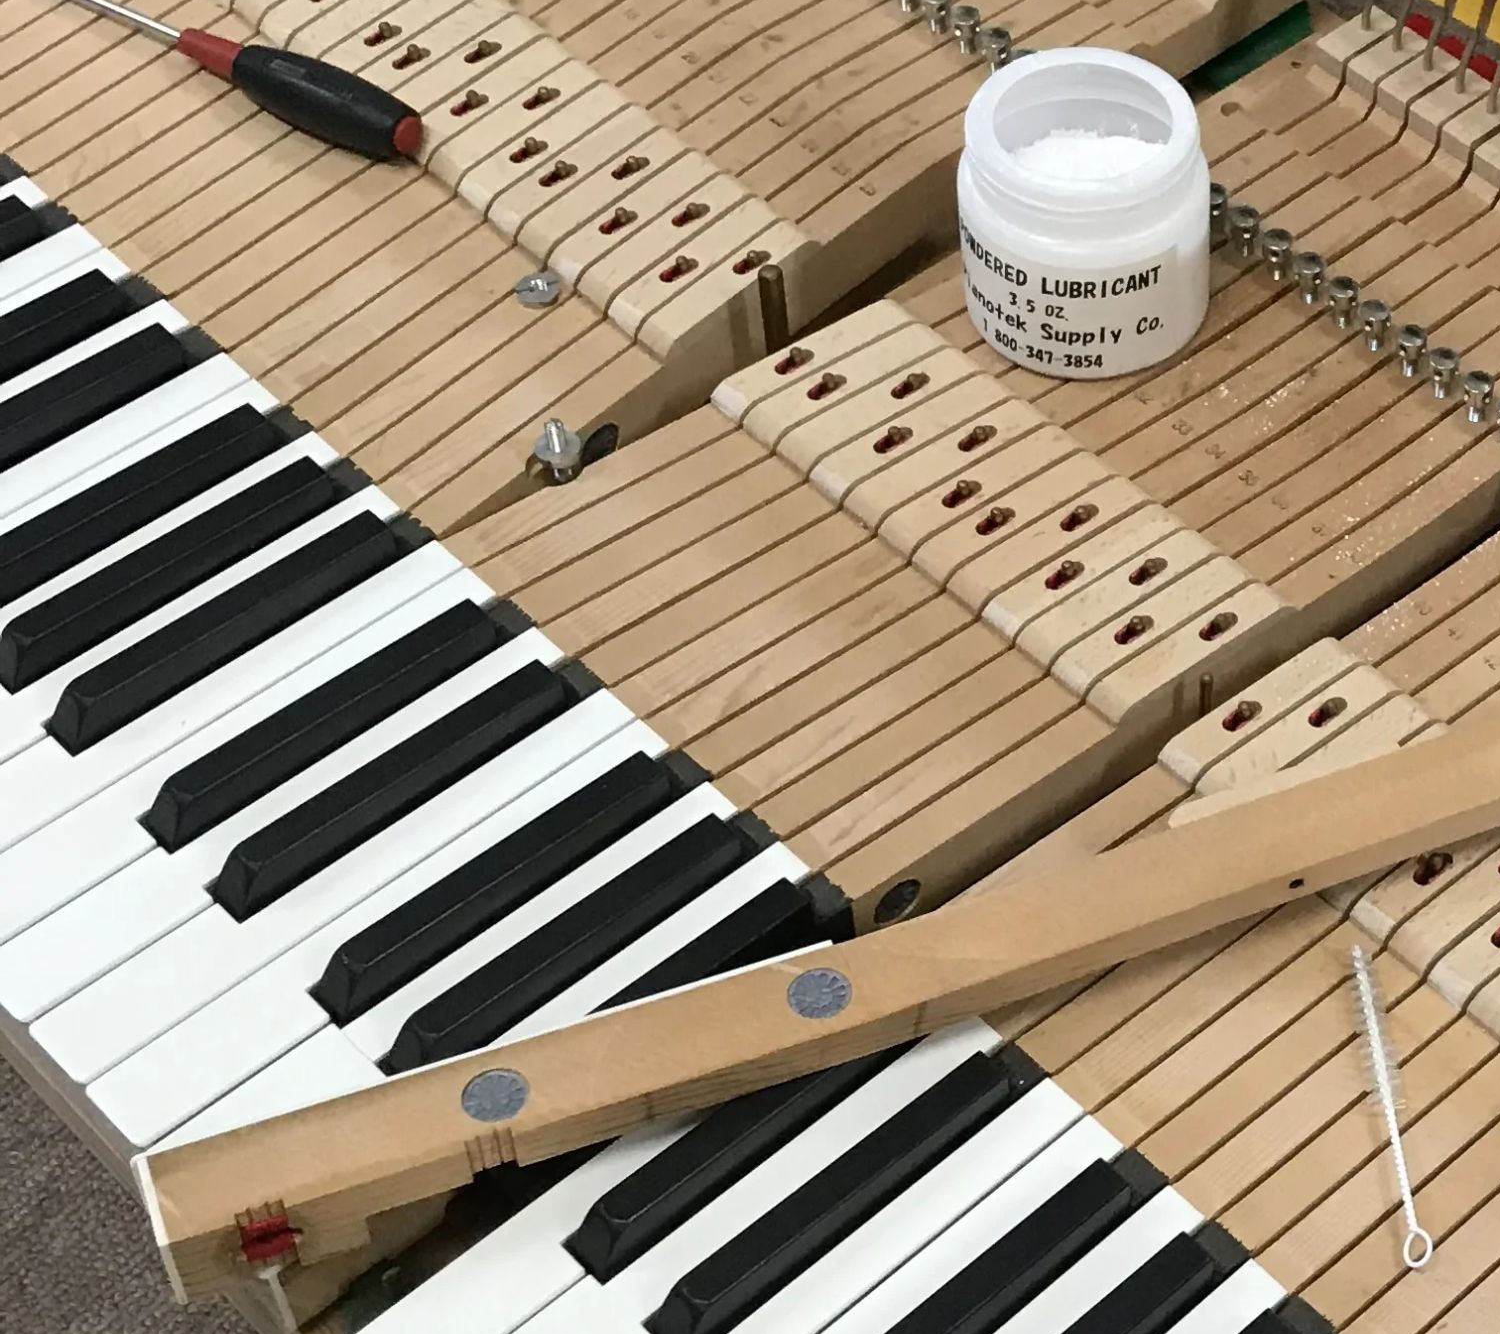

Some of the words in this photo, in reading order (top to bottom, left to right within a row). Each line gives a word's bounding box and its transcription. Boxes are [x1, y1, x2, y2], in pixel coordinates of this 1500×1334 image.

[1041, 264, 1162, 299] LUBRICANT
[1045, 304, 1069, 321] OZ.
[1040, 322, 1123, 347] Supply
[1136, 316, 1165, 336] Co.
